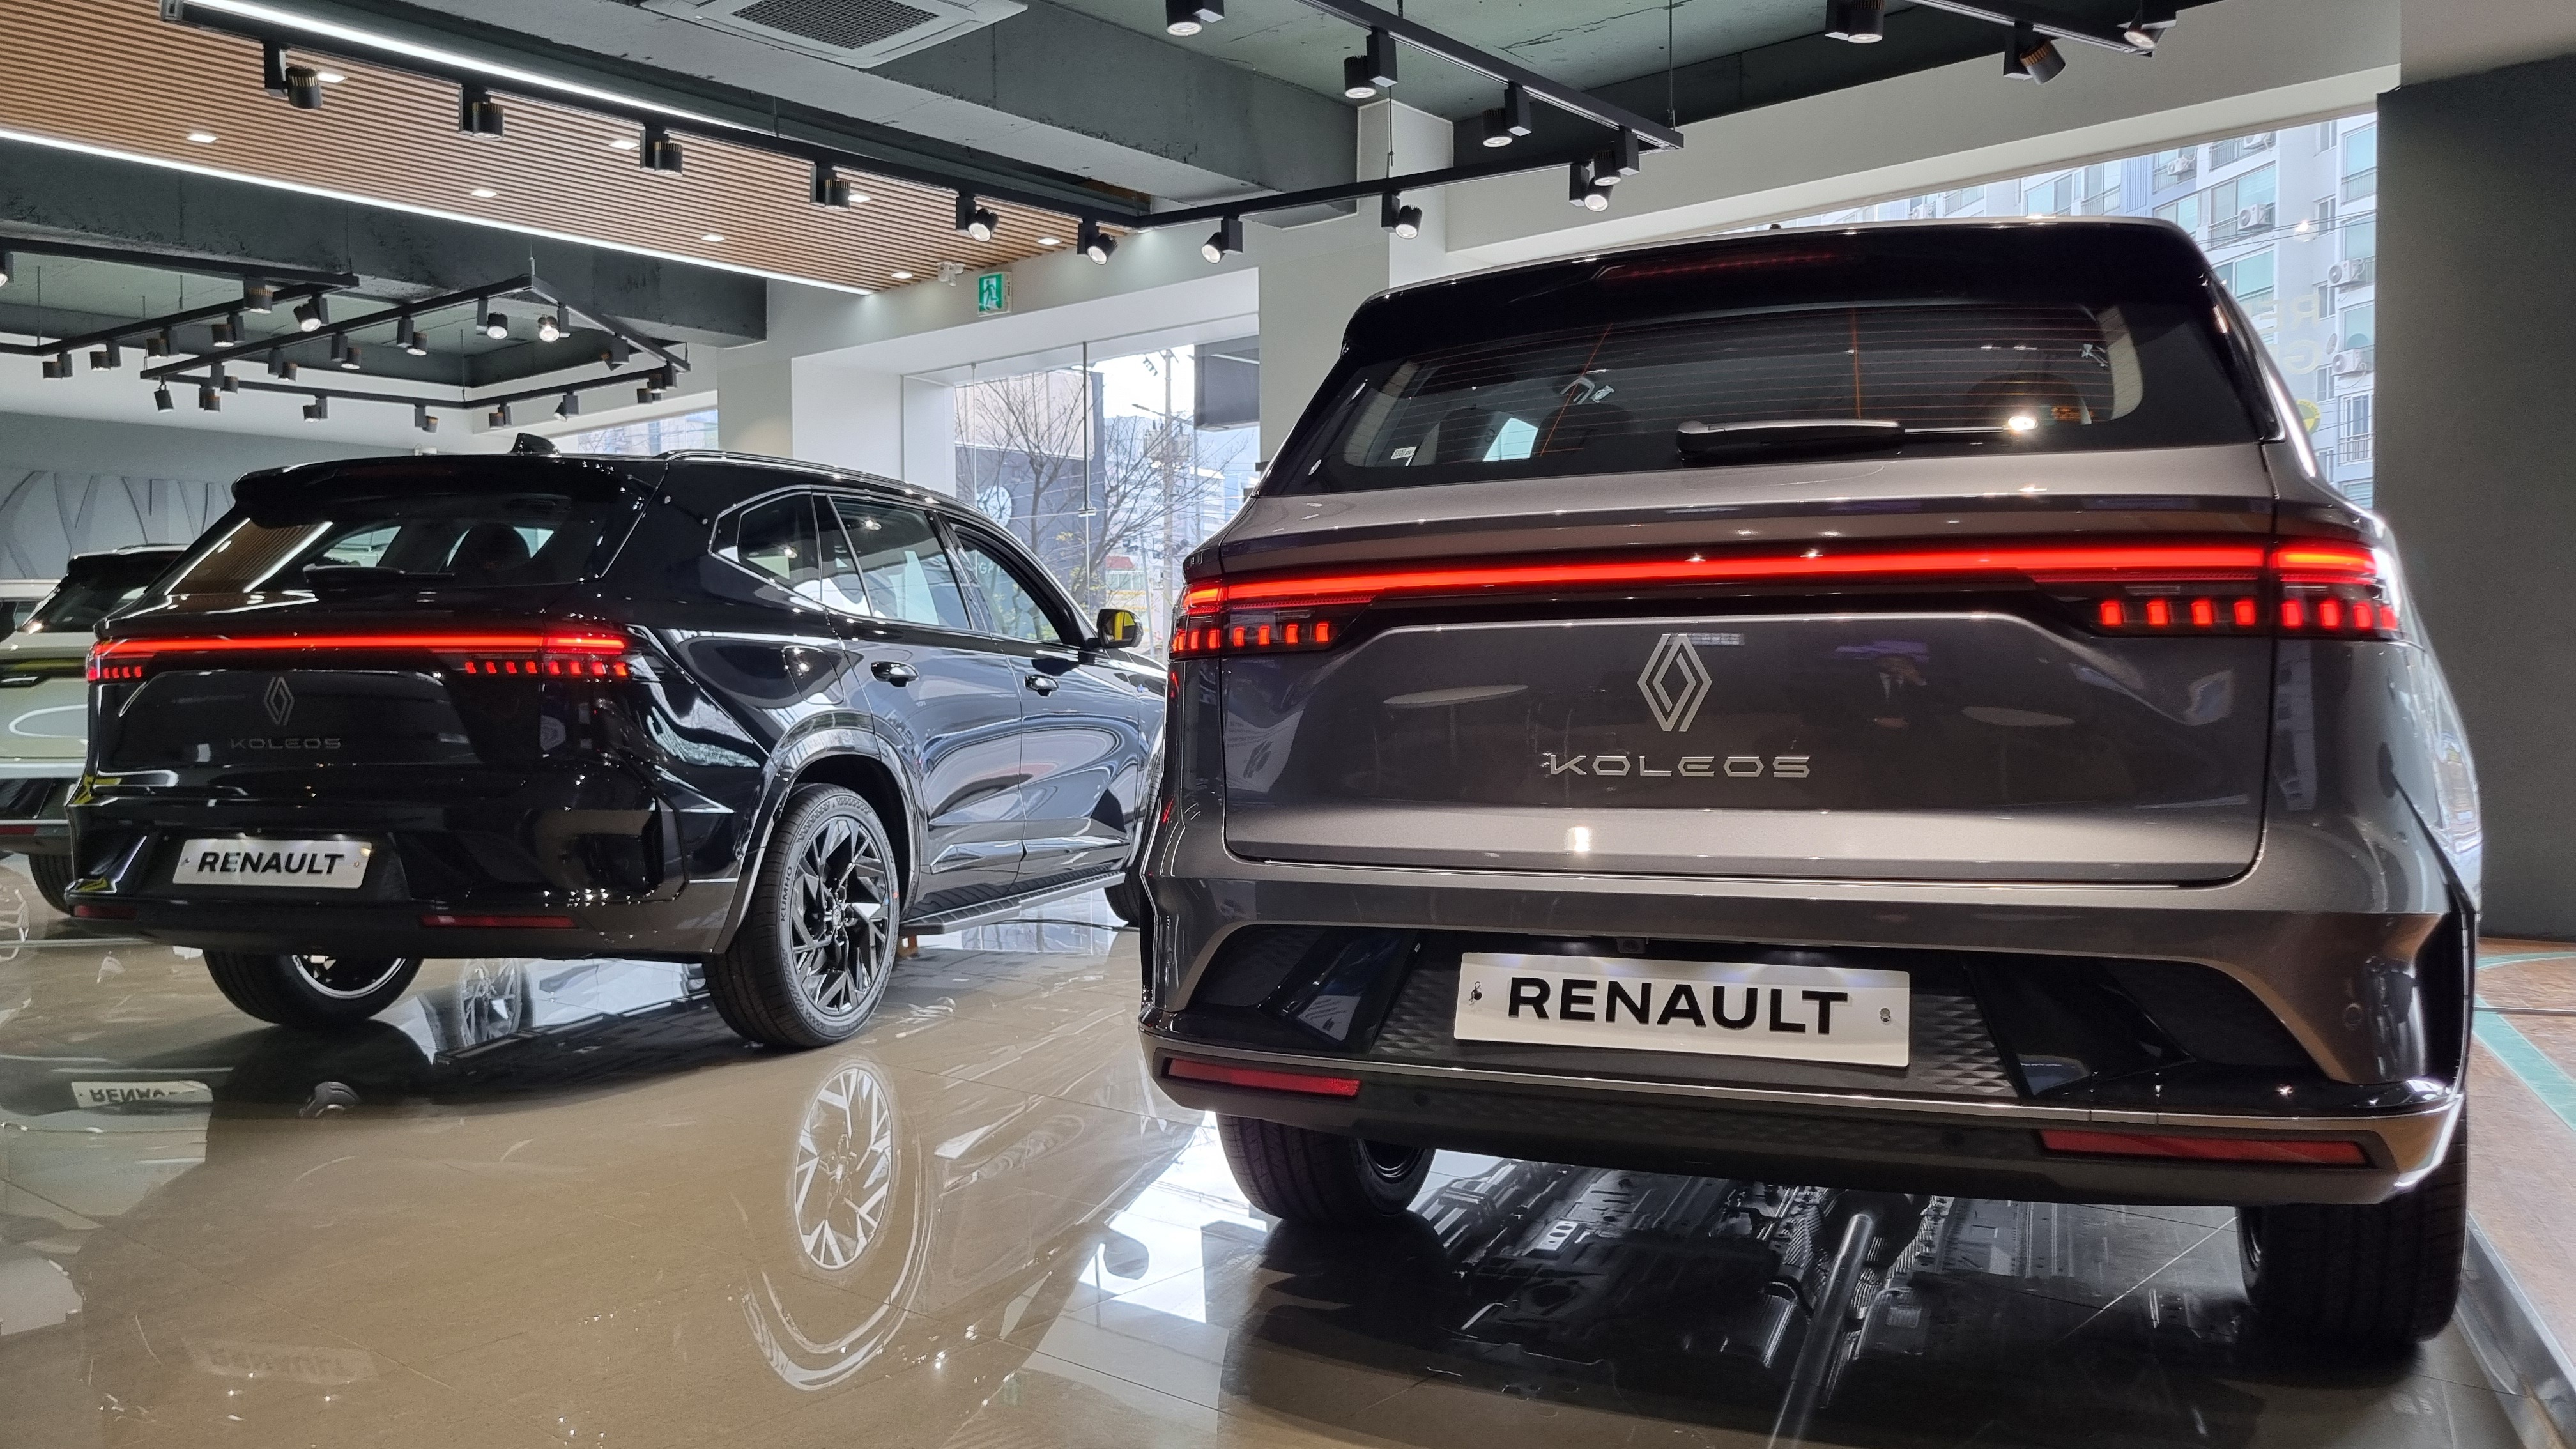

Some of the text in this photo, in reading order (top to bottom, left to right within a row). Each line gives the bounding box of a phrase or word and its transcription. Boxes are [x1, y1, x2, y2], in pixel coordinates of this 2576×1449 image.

[230, 737, 341, 749] KOLEOS
[1549, 754, 1811, 779] KOLEOS
[197, 850, 346, 875] RENAULT
[781, 866, 793, 921] KUMHO
[1507, 976, 1849, 1036] RENAULT
